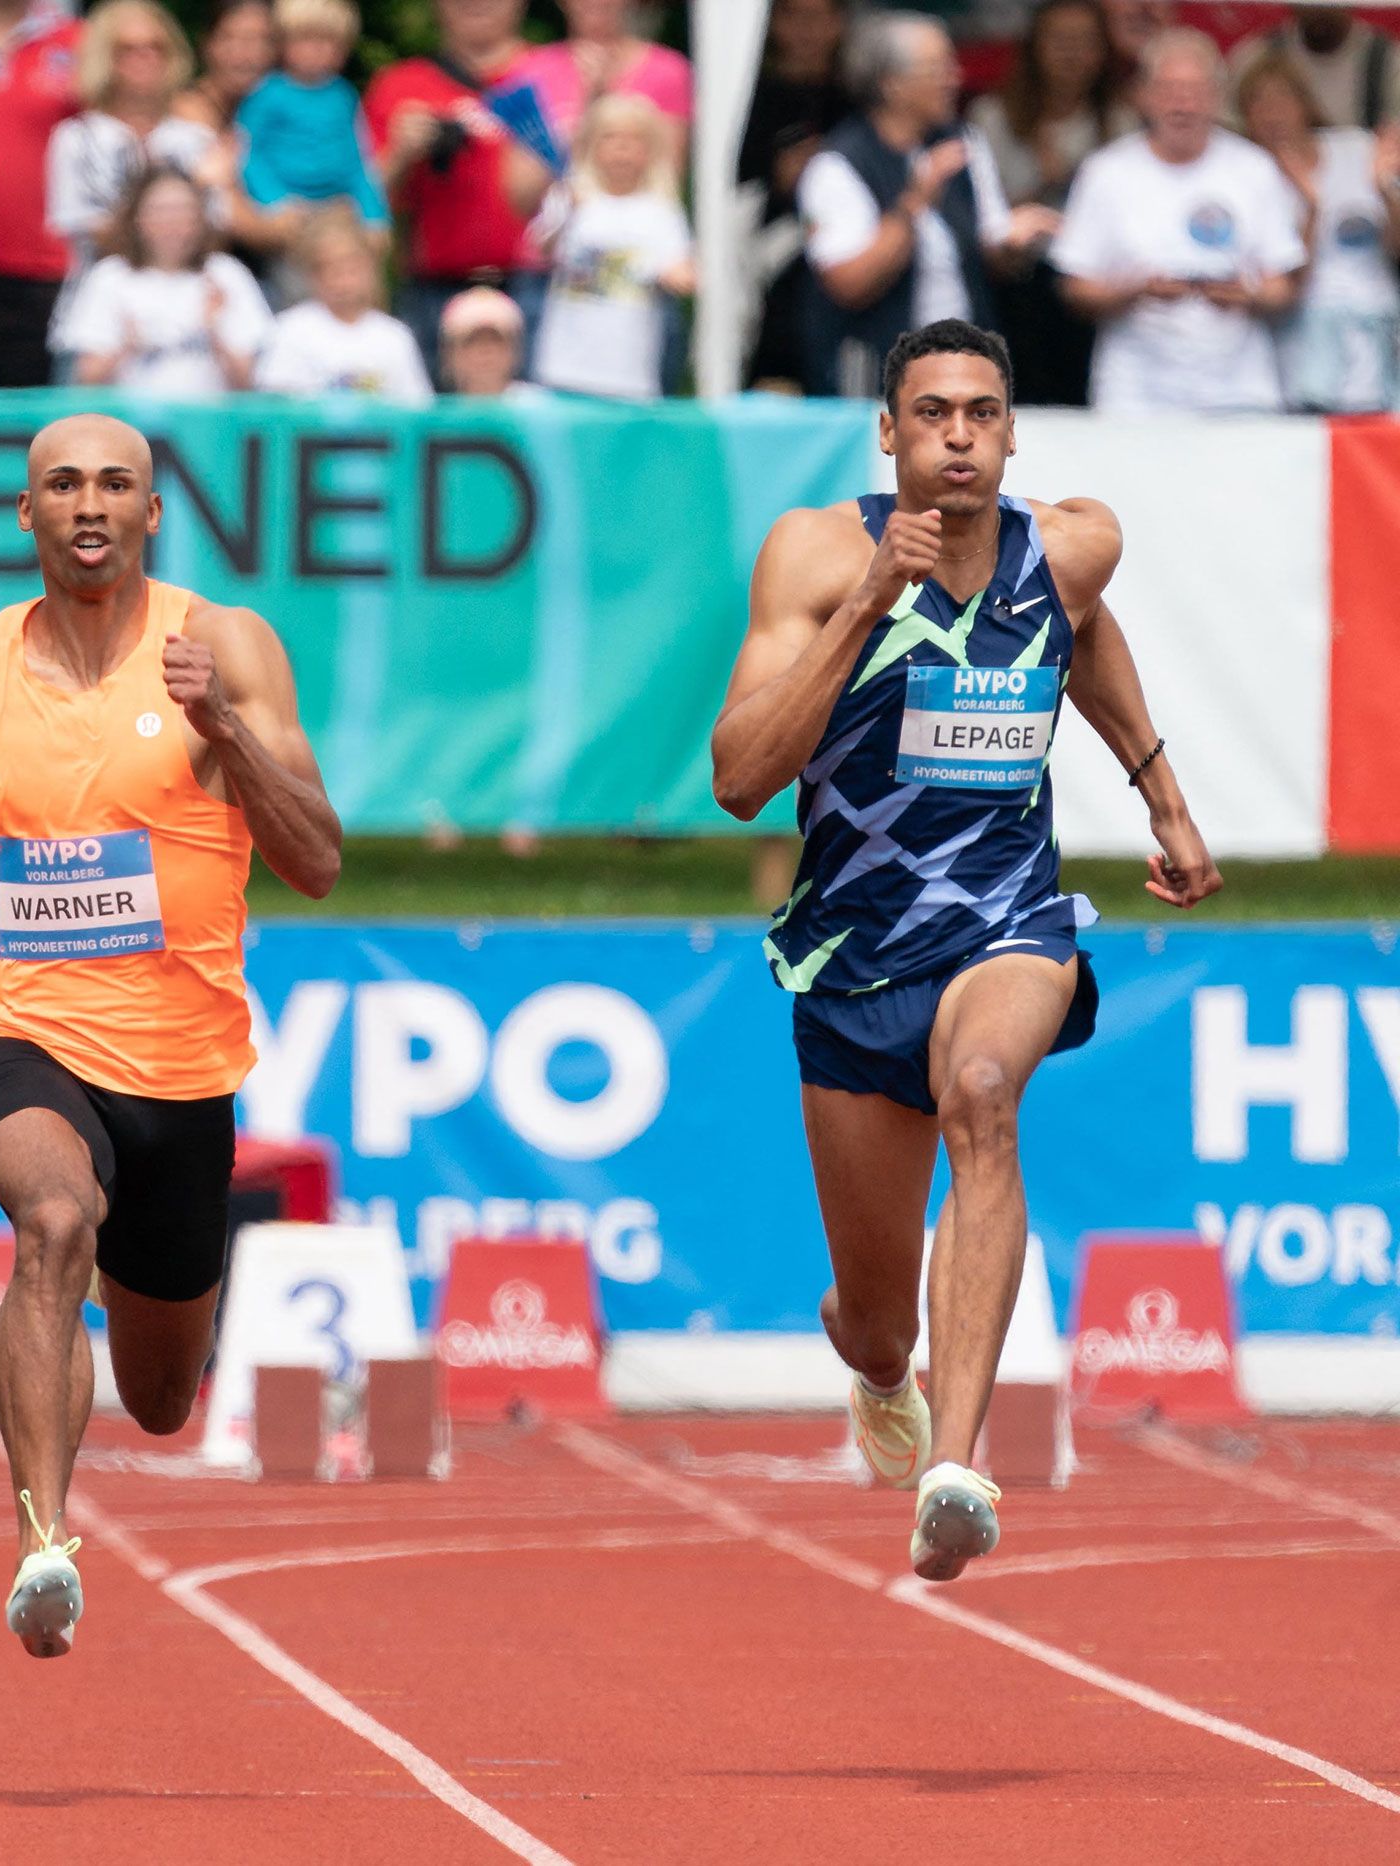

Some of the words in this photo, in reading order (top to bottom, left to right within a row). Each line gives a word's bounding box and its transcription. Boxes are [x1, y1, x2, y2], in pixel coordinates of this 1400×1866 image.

[953, 671, 1027, 694] HYPO
[953, 699, 1025, 711] VORARLBERG
[933, 725, 1035, 750] LEPAGE
[913, 766, 1006, 781] HYPOMEETING
[1008, 768, 1036, 782] GÖTZIS
[24, 839, 102, 865] HYPO
[26, 867, 104, 882] VORARLBERG
[11, 891, 136, 920] WARNER
[9, 939, 97, 954] HYPOMEETING
[100, 933, 149, 949] GÖTZIS
[243, 980, 669, 1161] YPO
[1194, 1202, 1400, 1287] VOR
[286, 1279, 354, 1379] 3
[1075, 1328, 1231, 1374] OMEGA
